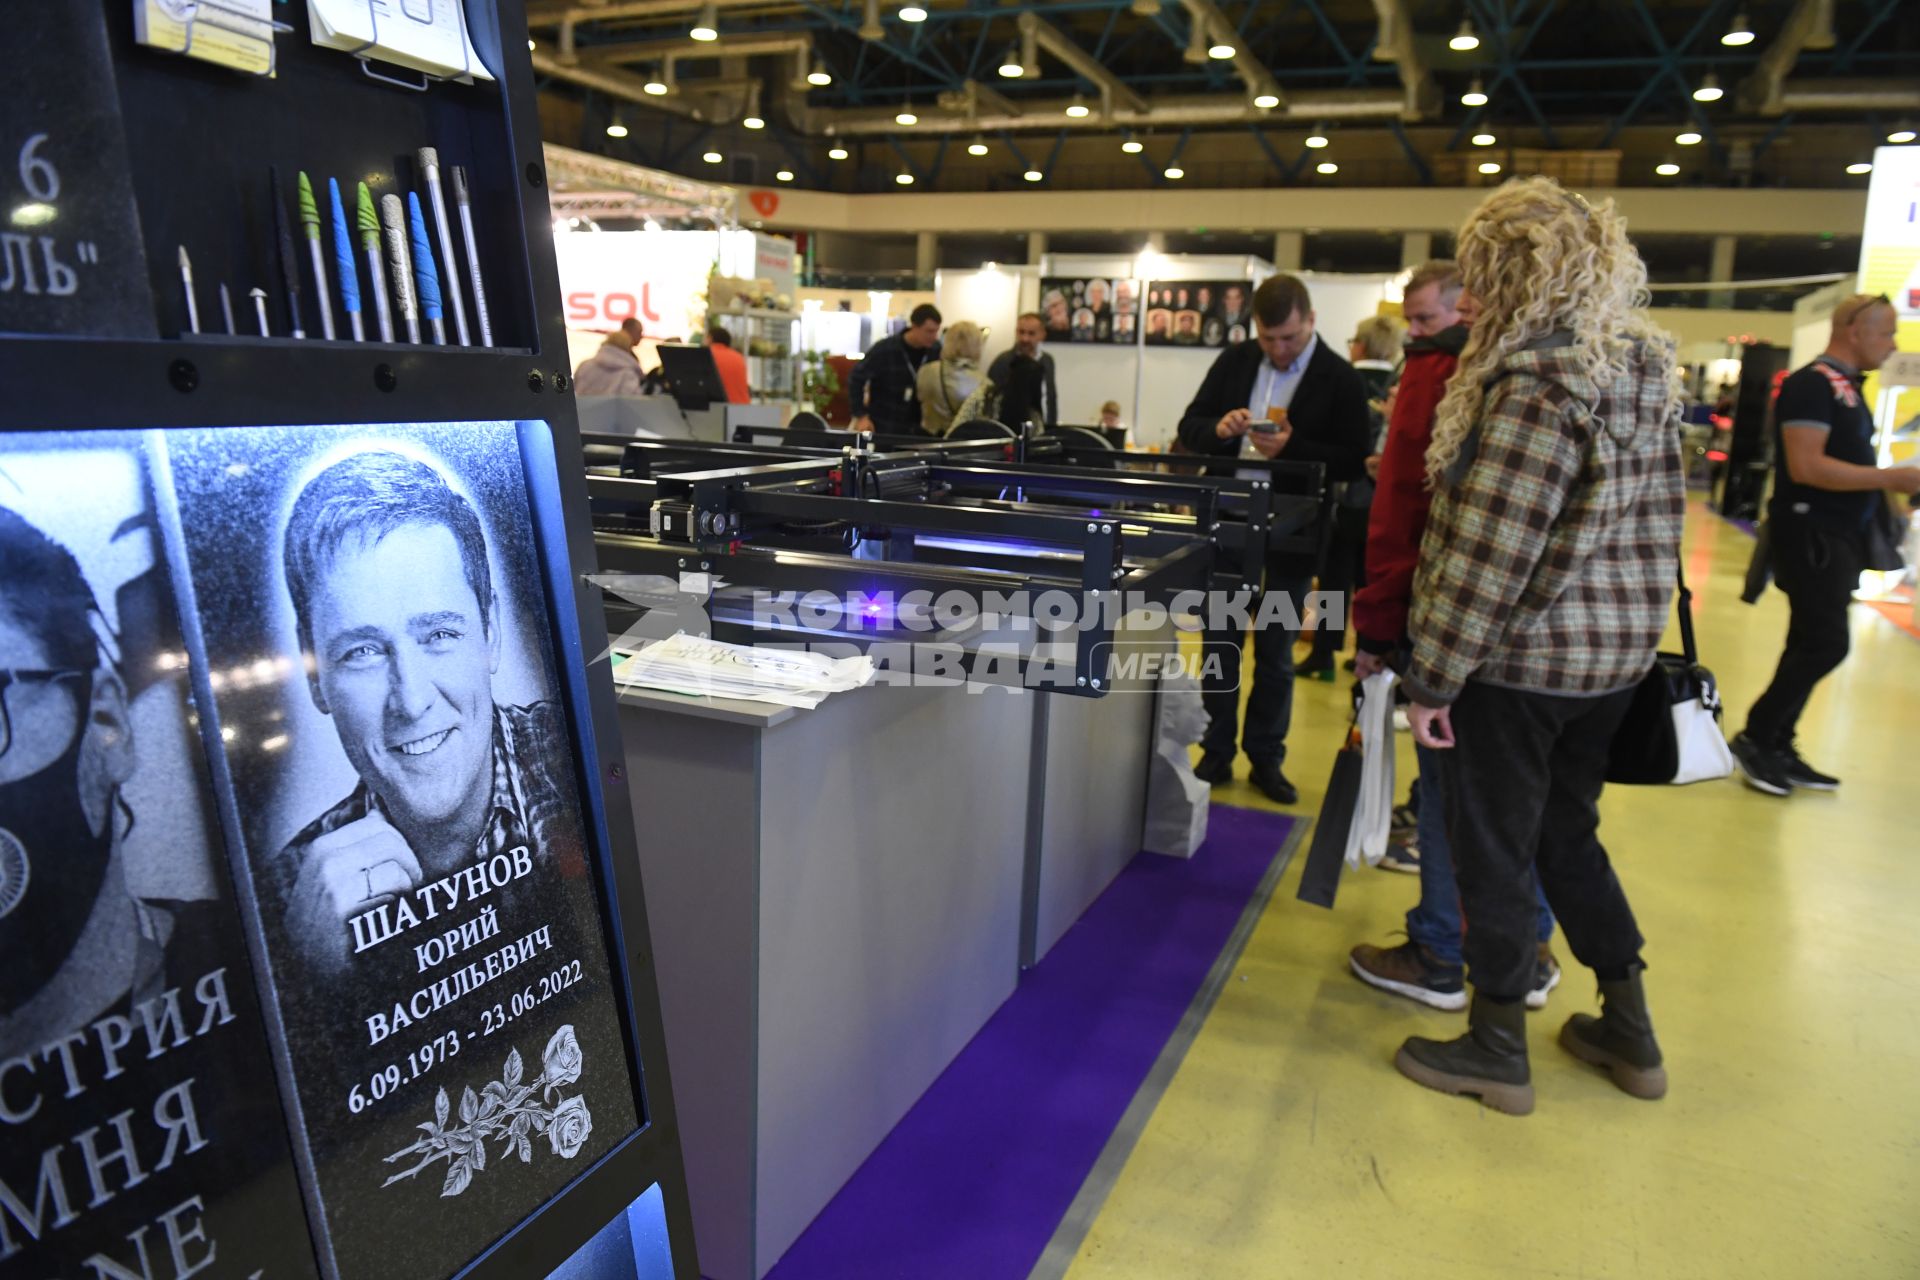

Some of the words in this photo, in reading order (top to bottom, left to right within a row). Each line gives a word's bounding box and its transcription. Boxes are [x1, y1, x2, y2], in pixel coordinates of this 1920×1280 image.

[19, 133, 61, 201] 6
[349, 846, 532, 953] ШАТУНОВ
[413, 904, 501, 973] ЮРИЙ
[349, 1030, 460, 1114] 6.09.1973
[481, 959, 583, 1037] 23.06.2022
[365, 925, 552, 1045] ВАСИЛЬЕВИЧ
[0, 967, 237, 1125] СТРИЯ
